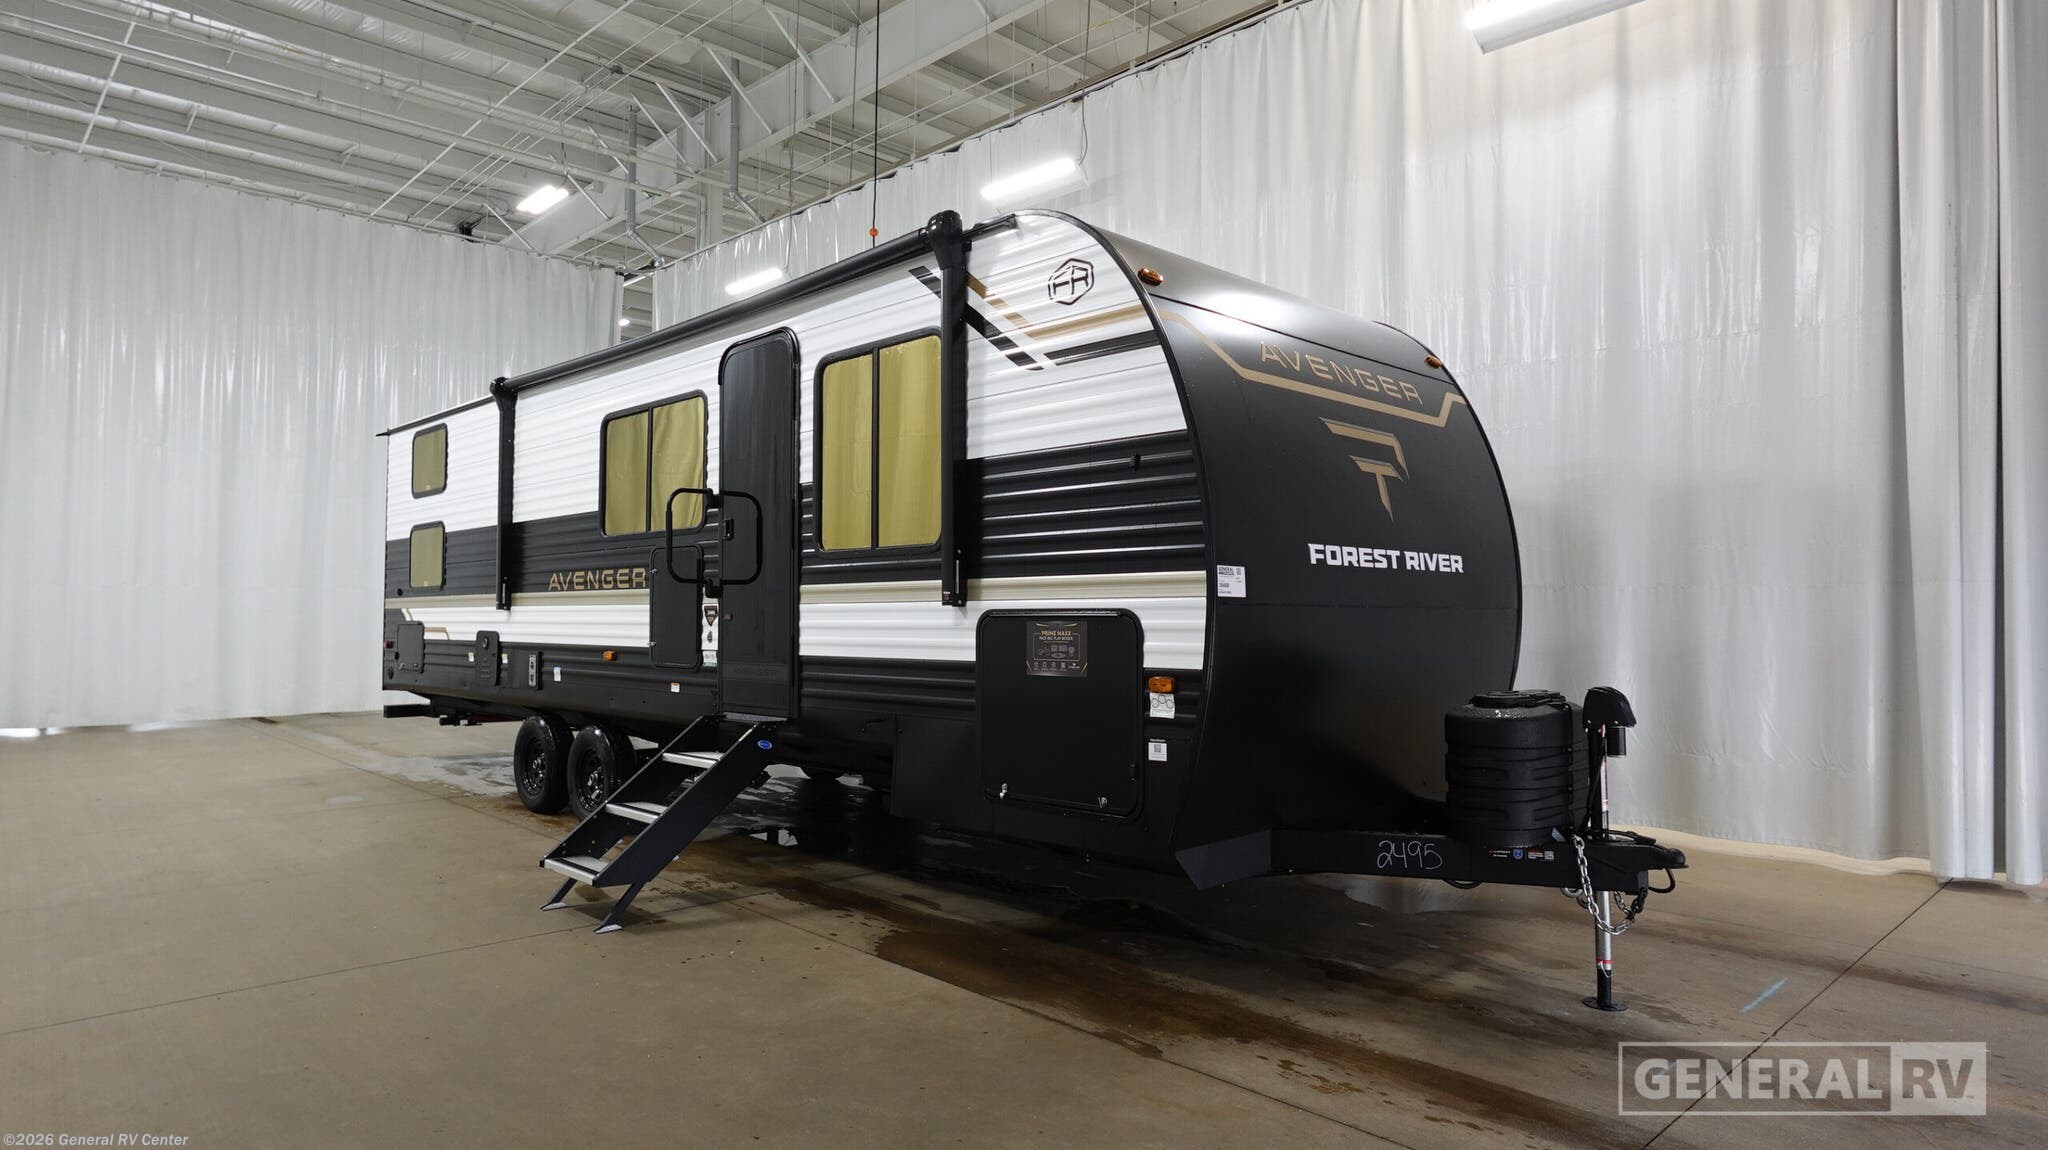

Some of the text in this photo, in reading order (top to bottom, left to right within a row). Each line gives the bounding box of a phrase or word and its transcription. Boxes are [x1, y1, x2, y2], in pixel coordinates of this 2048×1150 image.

[1260, 340, 1424, 406] AVENGER
[1307, 543, 1465, 573] FOREST RIVER
[547, 567, 647, 591] AVENGER
[1376, 840, 1443, 870] 2495
